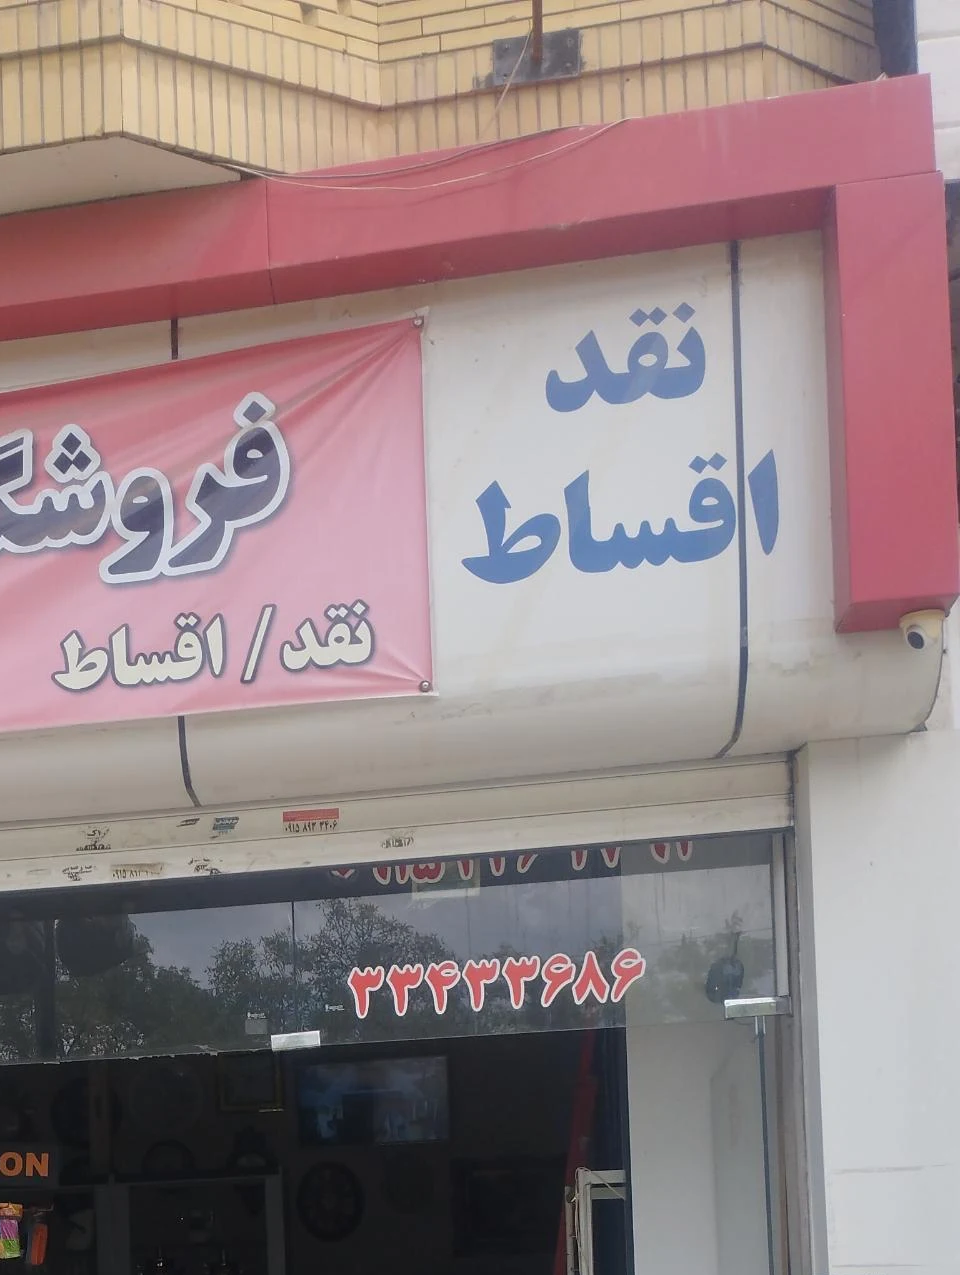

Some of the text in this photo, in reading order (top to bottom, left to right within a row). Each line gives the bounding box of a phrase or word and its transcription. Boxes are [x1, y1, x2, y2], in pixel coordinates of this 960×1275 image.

[545, 302, 706, 412] نقد
[461, 448, 780, 584] اقساط
[53, 613, 226, 693] اقساط
[348, 947, 647, 1019] ۳۳۴۳۳۶۸۶
